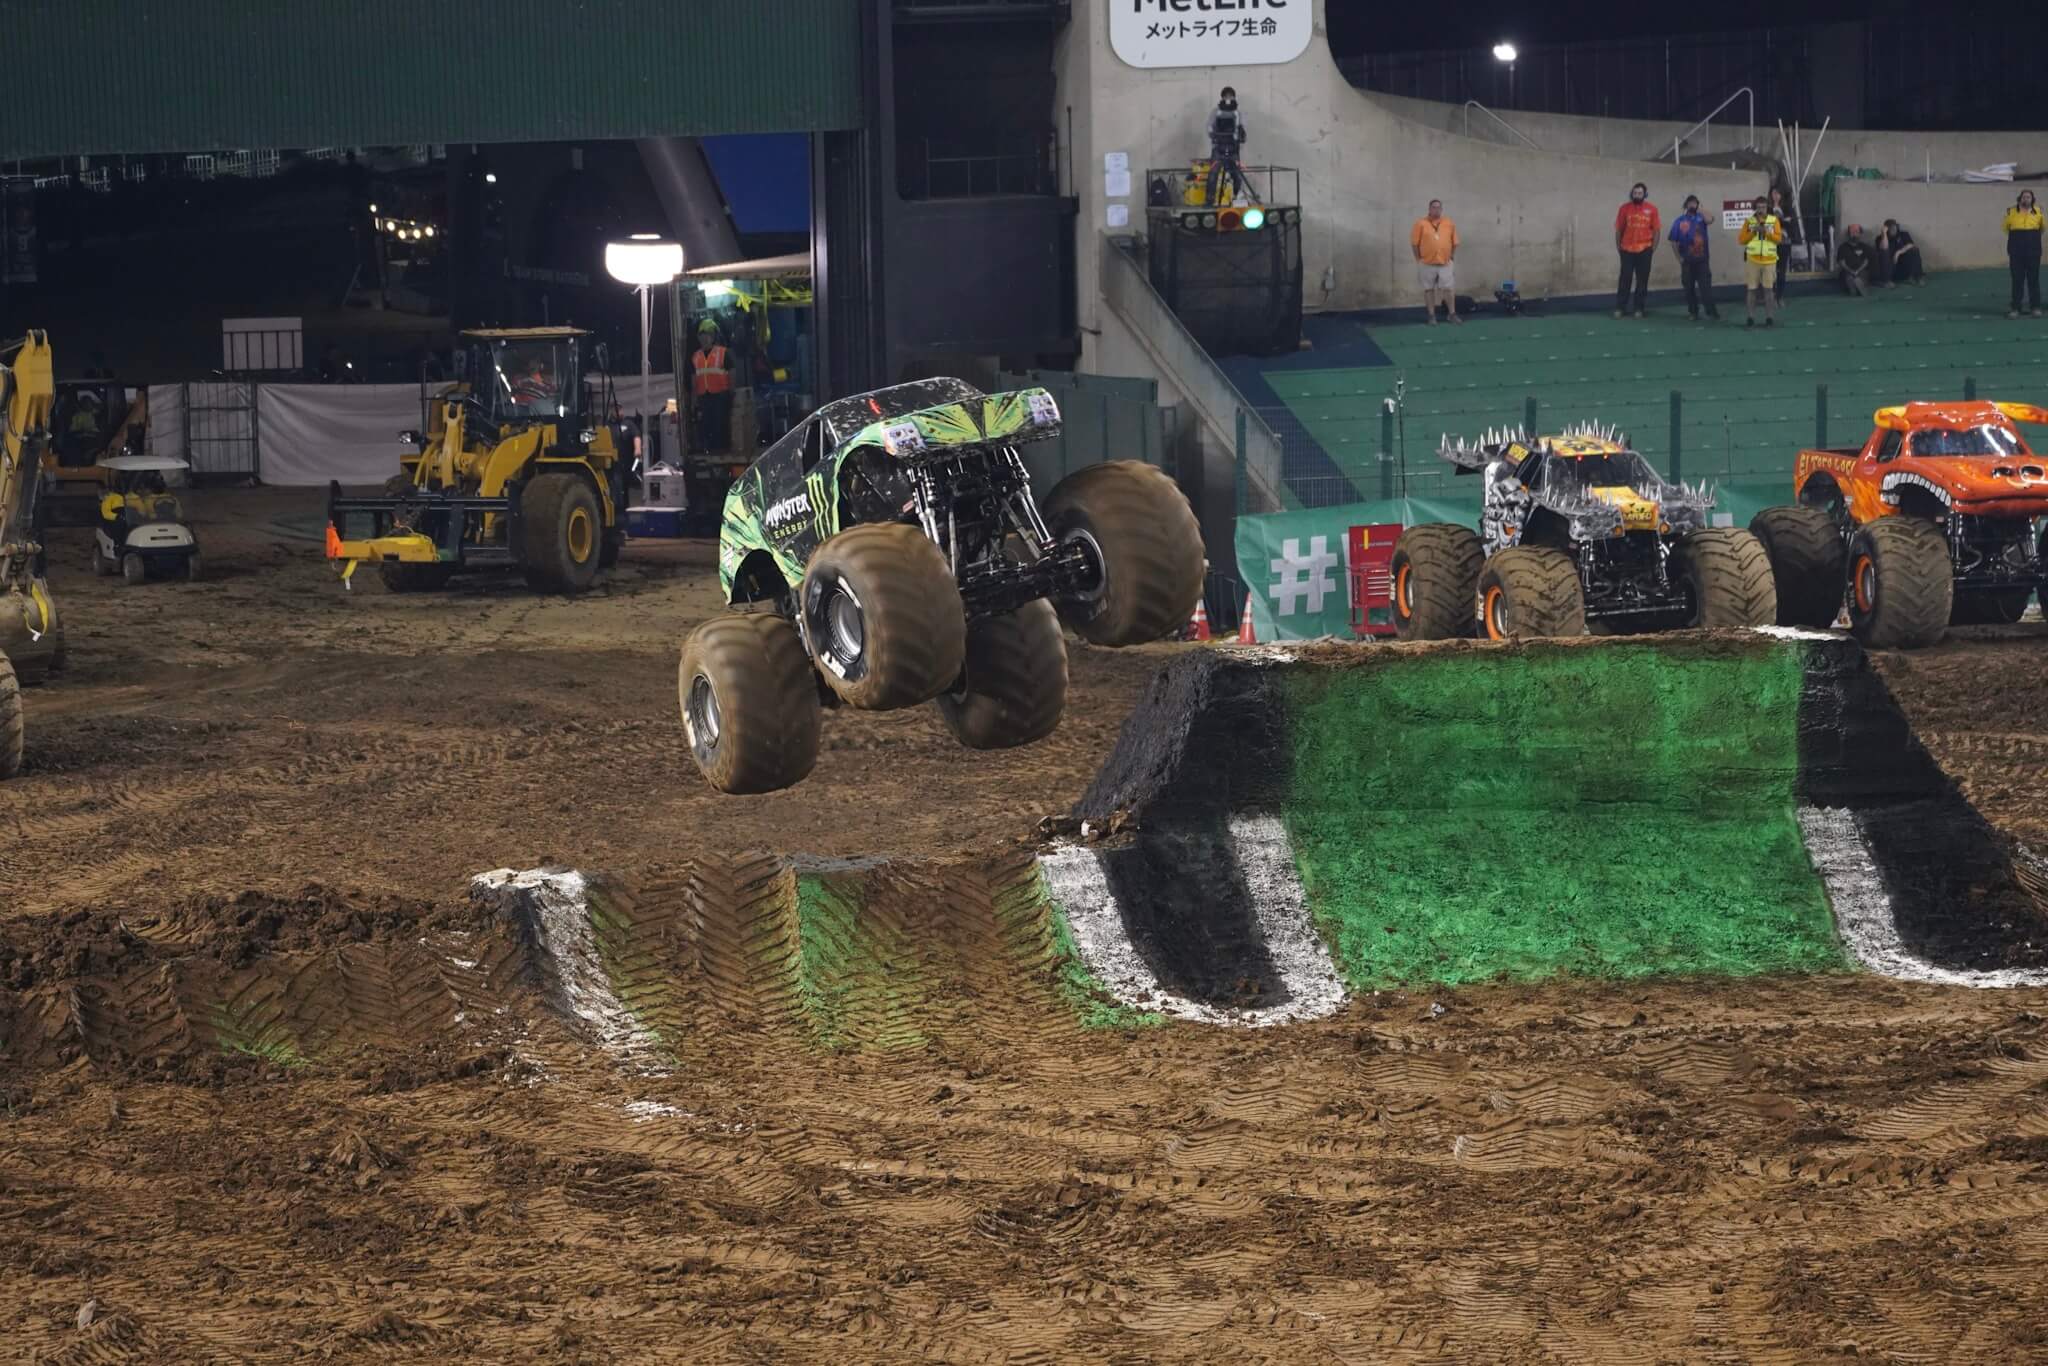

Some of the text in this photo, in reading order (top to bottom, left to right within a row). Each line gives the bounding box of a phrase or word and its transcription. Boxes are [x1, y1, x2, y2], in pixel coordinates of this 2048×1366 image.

[1145, 17, 1277, 39] メットライフ生命
[765, 493, 812, 529] MONSTER
[773, 520, 807, 539] ENERGY
